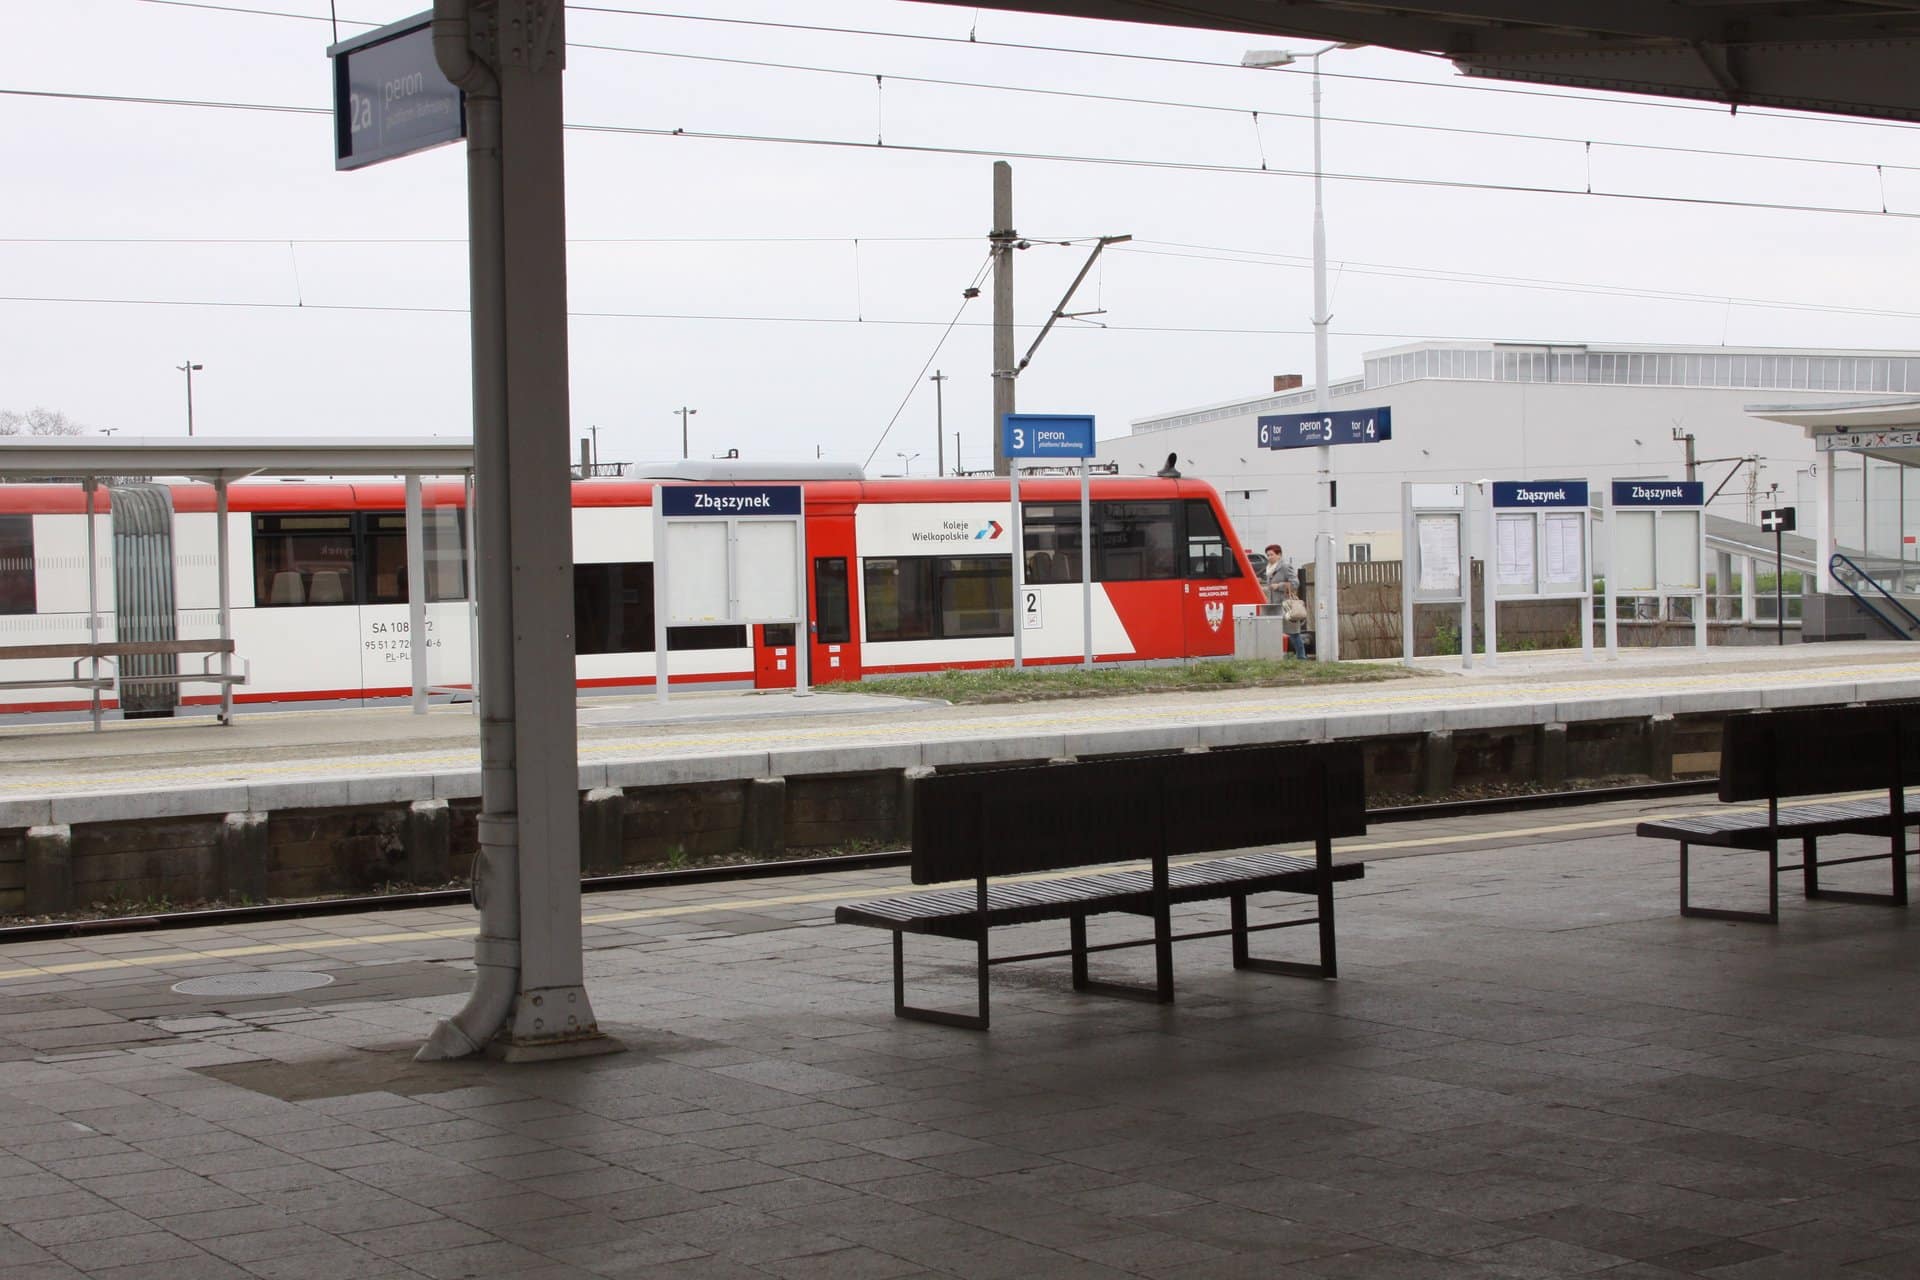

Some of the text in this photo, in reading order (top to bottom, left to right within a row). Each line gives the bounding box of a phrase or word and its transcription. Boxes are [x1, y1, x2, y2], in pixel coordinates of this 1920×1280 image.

[385, 71, 423, 112] peron
[350, 93, 371, 133] 2a
[1037, 431, 1065, 442] peron
[1260, 424, 1269, 443] 6
[1272, 424, 1282, 434] tor
[1300, 420, 1321, 434] peron
[1323, 417, 1333, 440] 3
[1351, 421, 1361, 430] tor
[1365, 418, 1375, 438] 4
[1013, 428, 1025, 449] 3
[1516, 488, 1566, 503] Zbąszynek
[1632, 486, 1683, 500] Zbąszynek
[694, 493, 770, 511] Zbąszynek
[943, 520, 969, 531] Koleje
[912, 532, 969, 542] Wielkopolskie
[1026, 592, 1037, 612] 2
[372, 622, 387, 633] SA
[364, 641, 376, 650] 95
[378, 640, 388, 650] 51
[391, 640, 397, 648] 2
